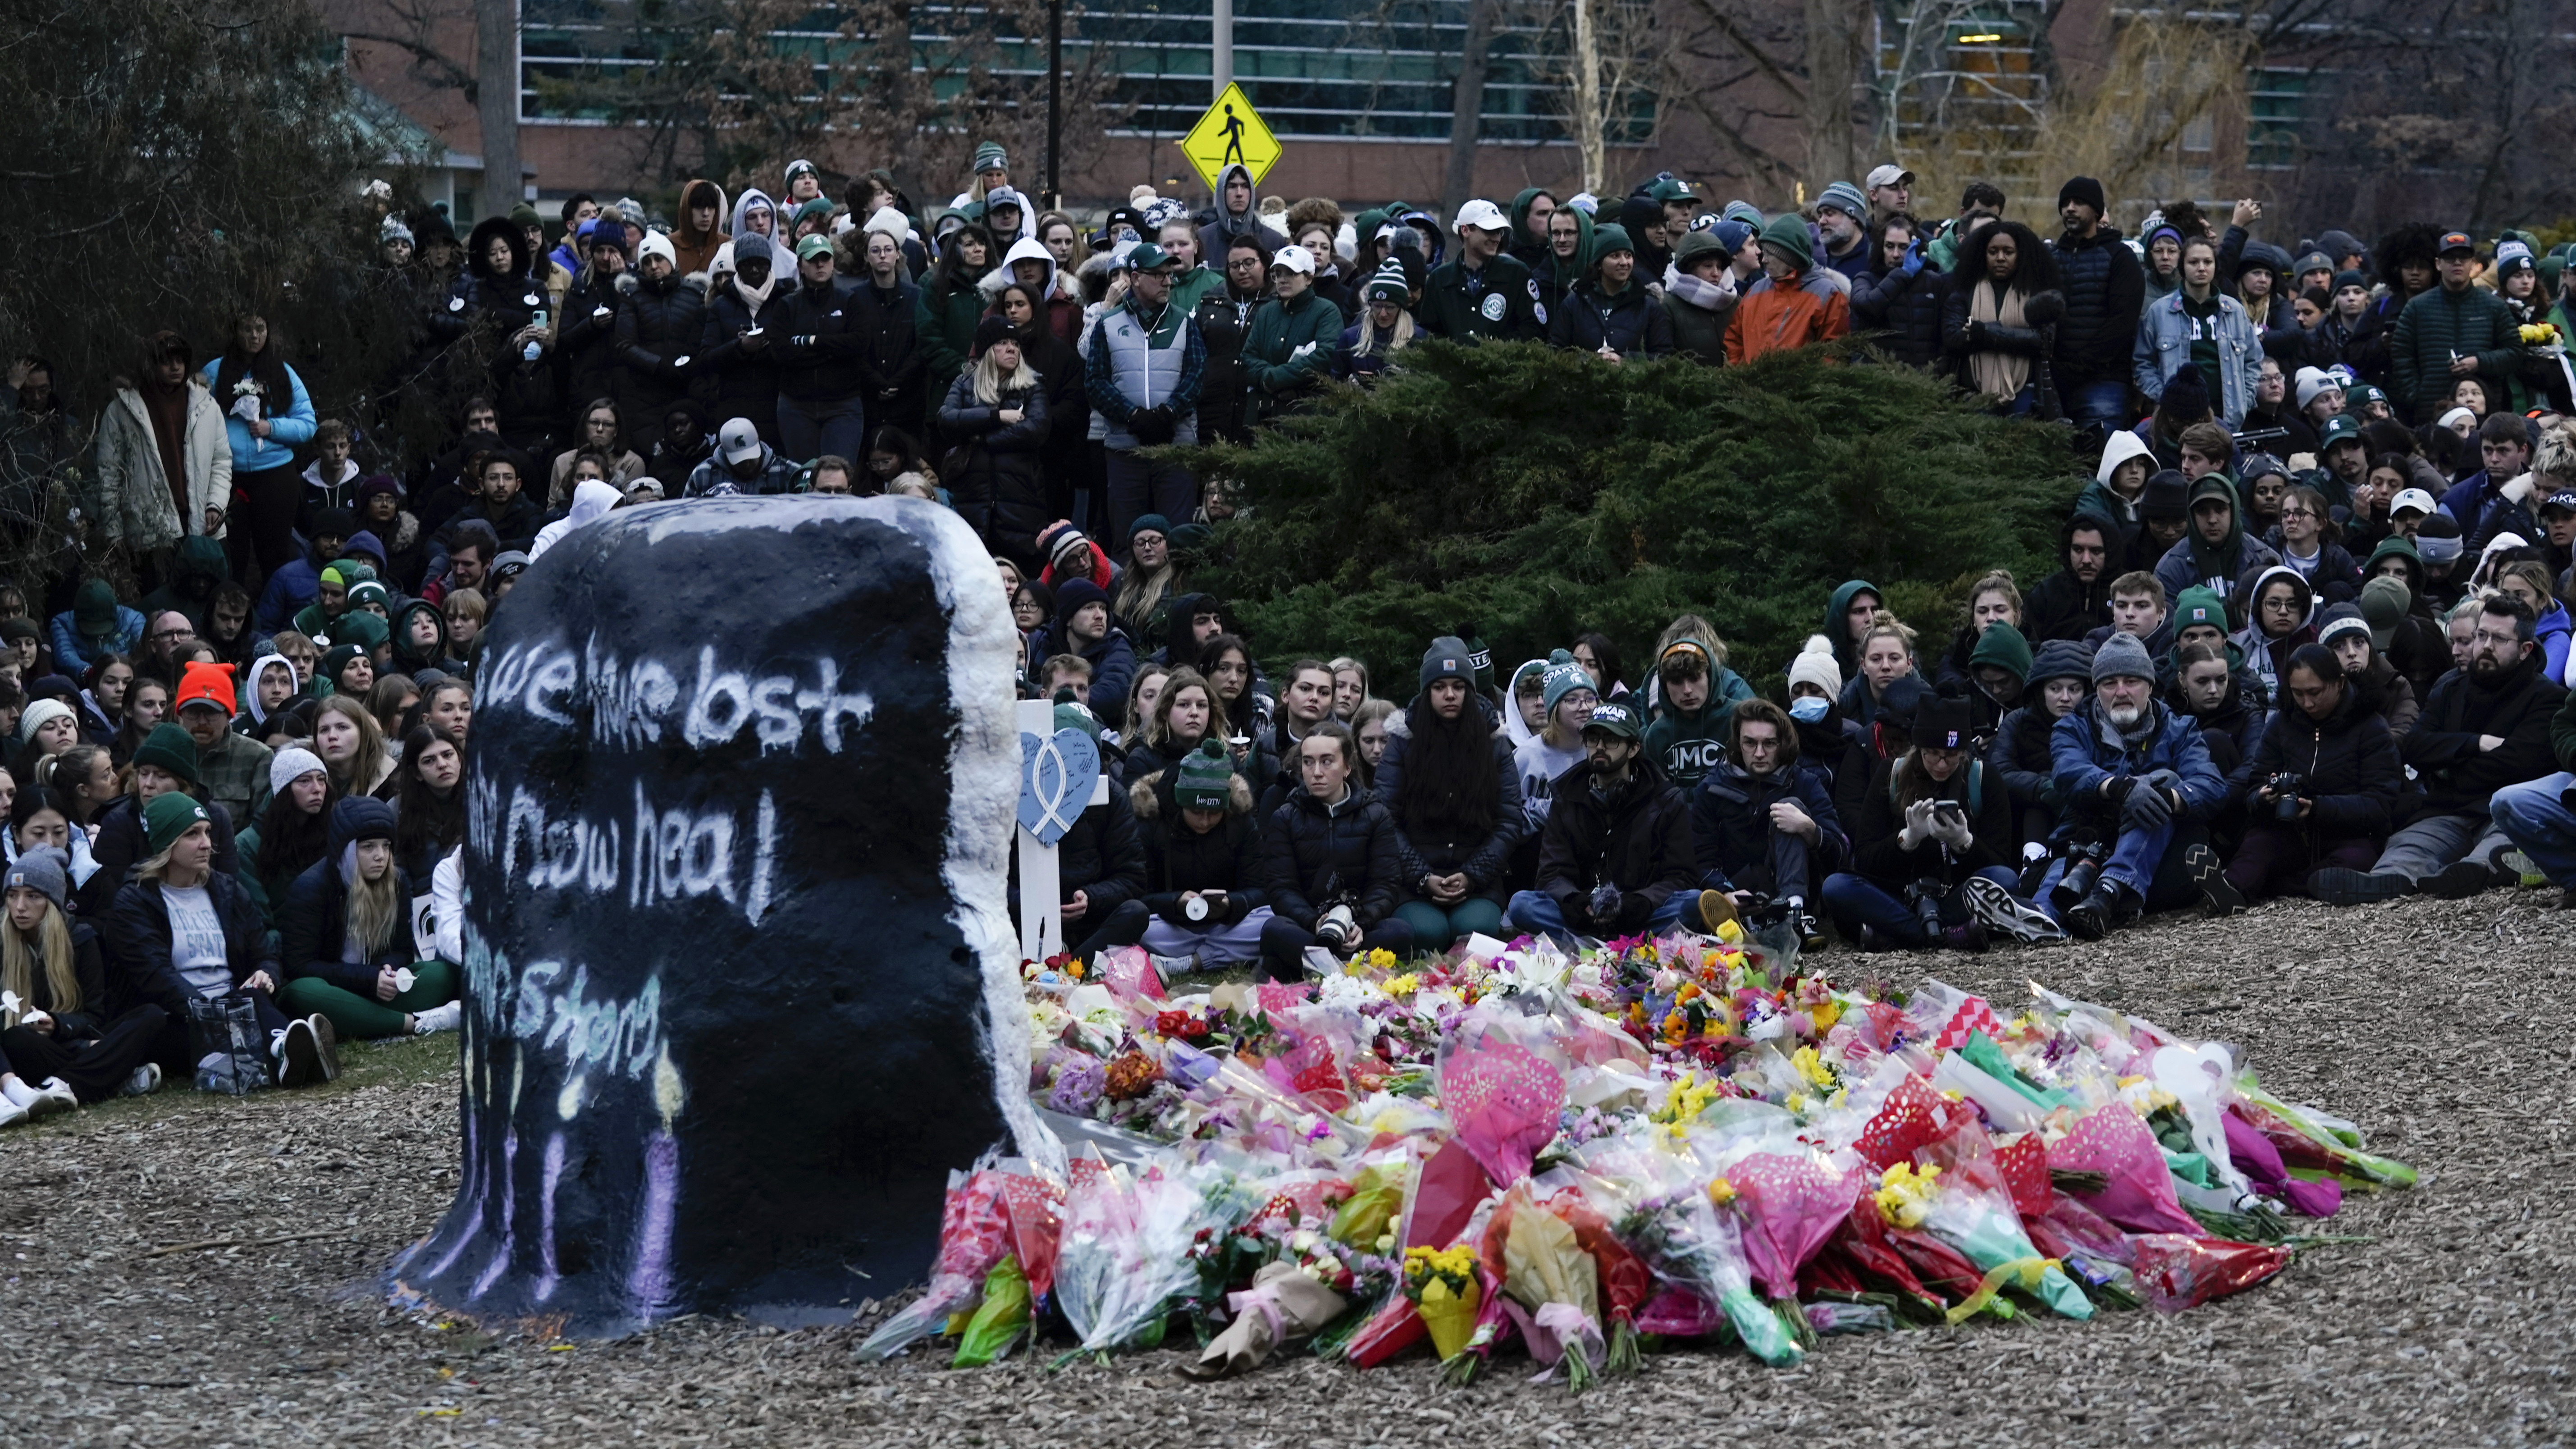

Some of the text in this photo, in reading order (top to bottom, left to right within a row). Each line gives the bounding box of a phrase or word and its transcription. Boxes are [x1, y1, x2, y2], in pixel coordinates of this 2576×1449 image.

[1375, 290, 1387, 300] MSU
[1488, 302, 1502, 312] MSU
[1592, 705, 1626, 720] WKAR
[1947, 736, 1958, 747] 17
[1668, 743, 1719, 770] JMC
[186, 933, 224, 958] STAT
